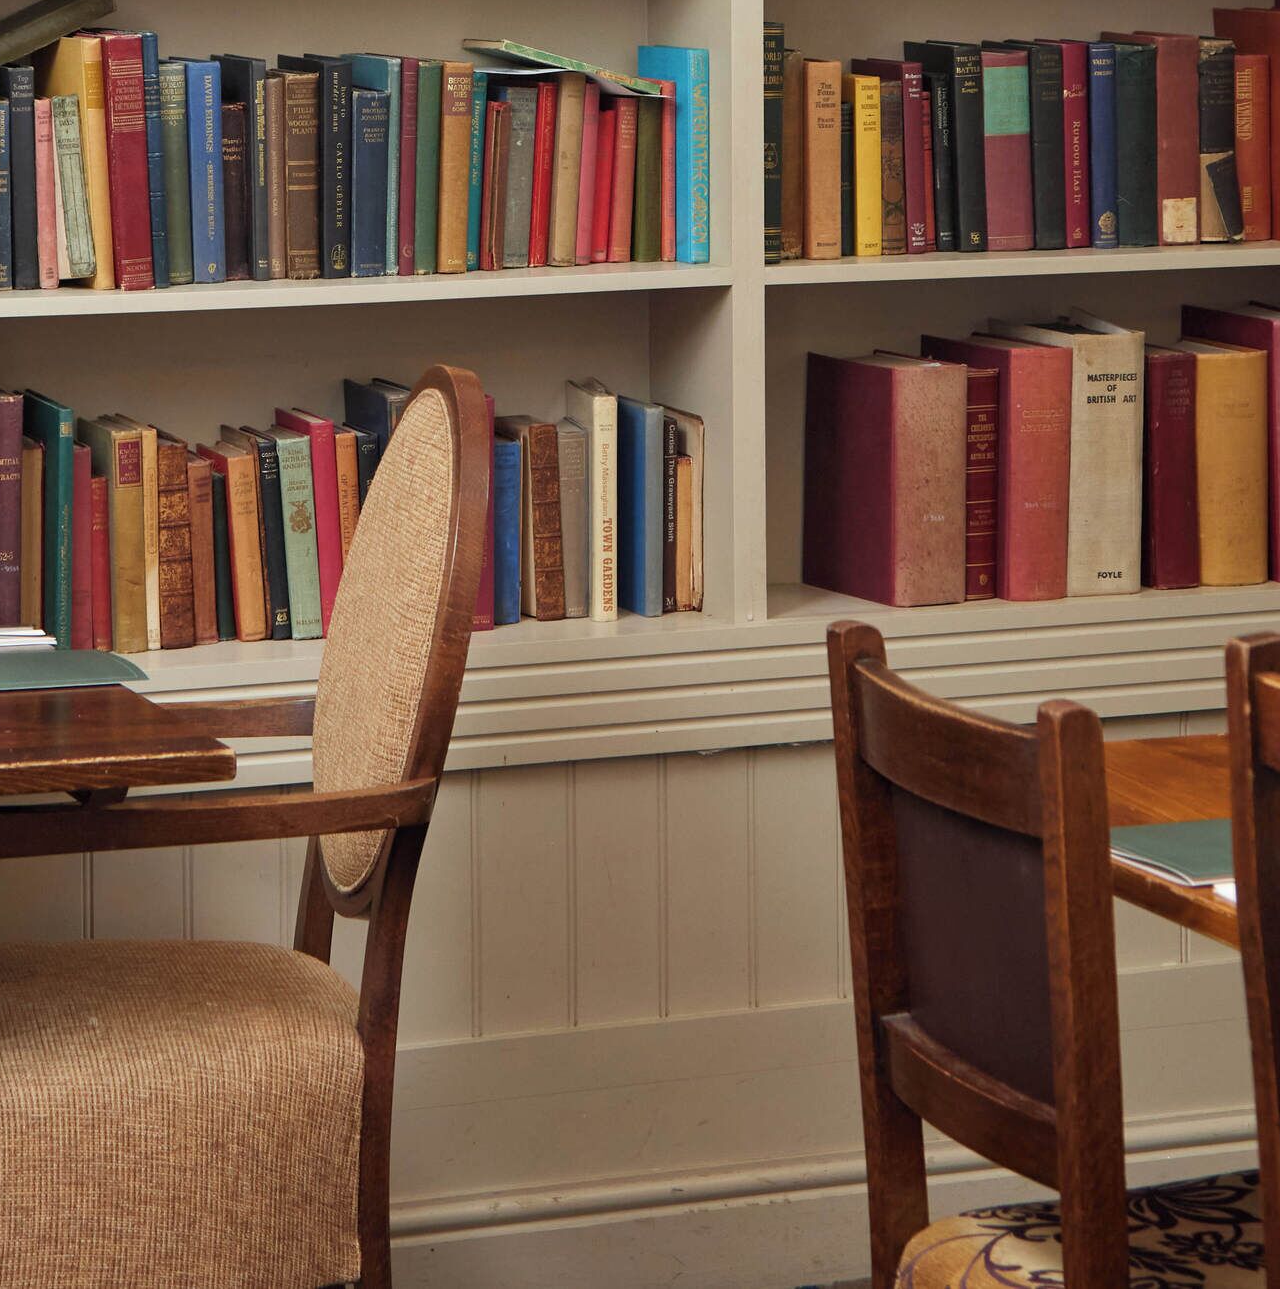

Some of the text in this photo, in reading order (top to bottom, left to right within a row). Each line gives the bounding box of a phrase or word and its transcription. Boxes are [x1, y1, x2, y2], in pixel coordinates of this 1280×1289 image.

[956, 67, 980, 75] BATTLE
[203, 75, 214, 153] DAVID EDDINGS
[341, 108, 347, 118] to
[692, 83, 707, 133] WATER
[1072, 121, 1082, 205] RUMOUR HAS IT
[692, 183, 707, 243] GARDEN
[1087, 373, 1137, 383] MASTERPIECES
[1106, 384, 1117, 392] OF
[1086, 394, 1137, 404] BRITISH ART
[600, 443, 610, 467] Betty
[667, 425, 676, 542] Curtiss The Graveyard Shift
[602, 518, 613, 553] TOWN
[602, 557, 613, 613] GARDENS
[1097, 571, 1123, 579] FOYLE
